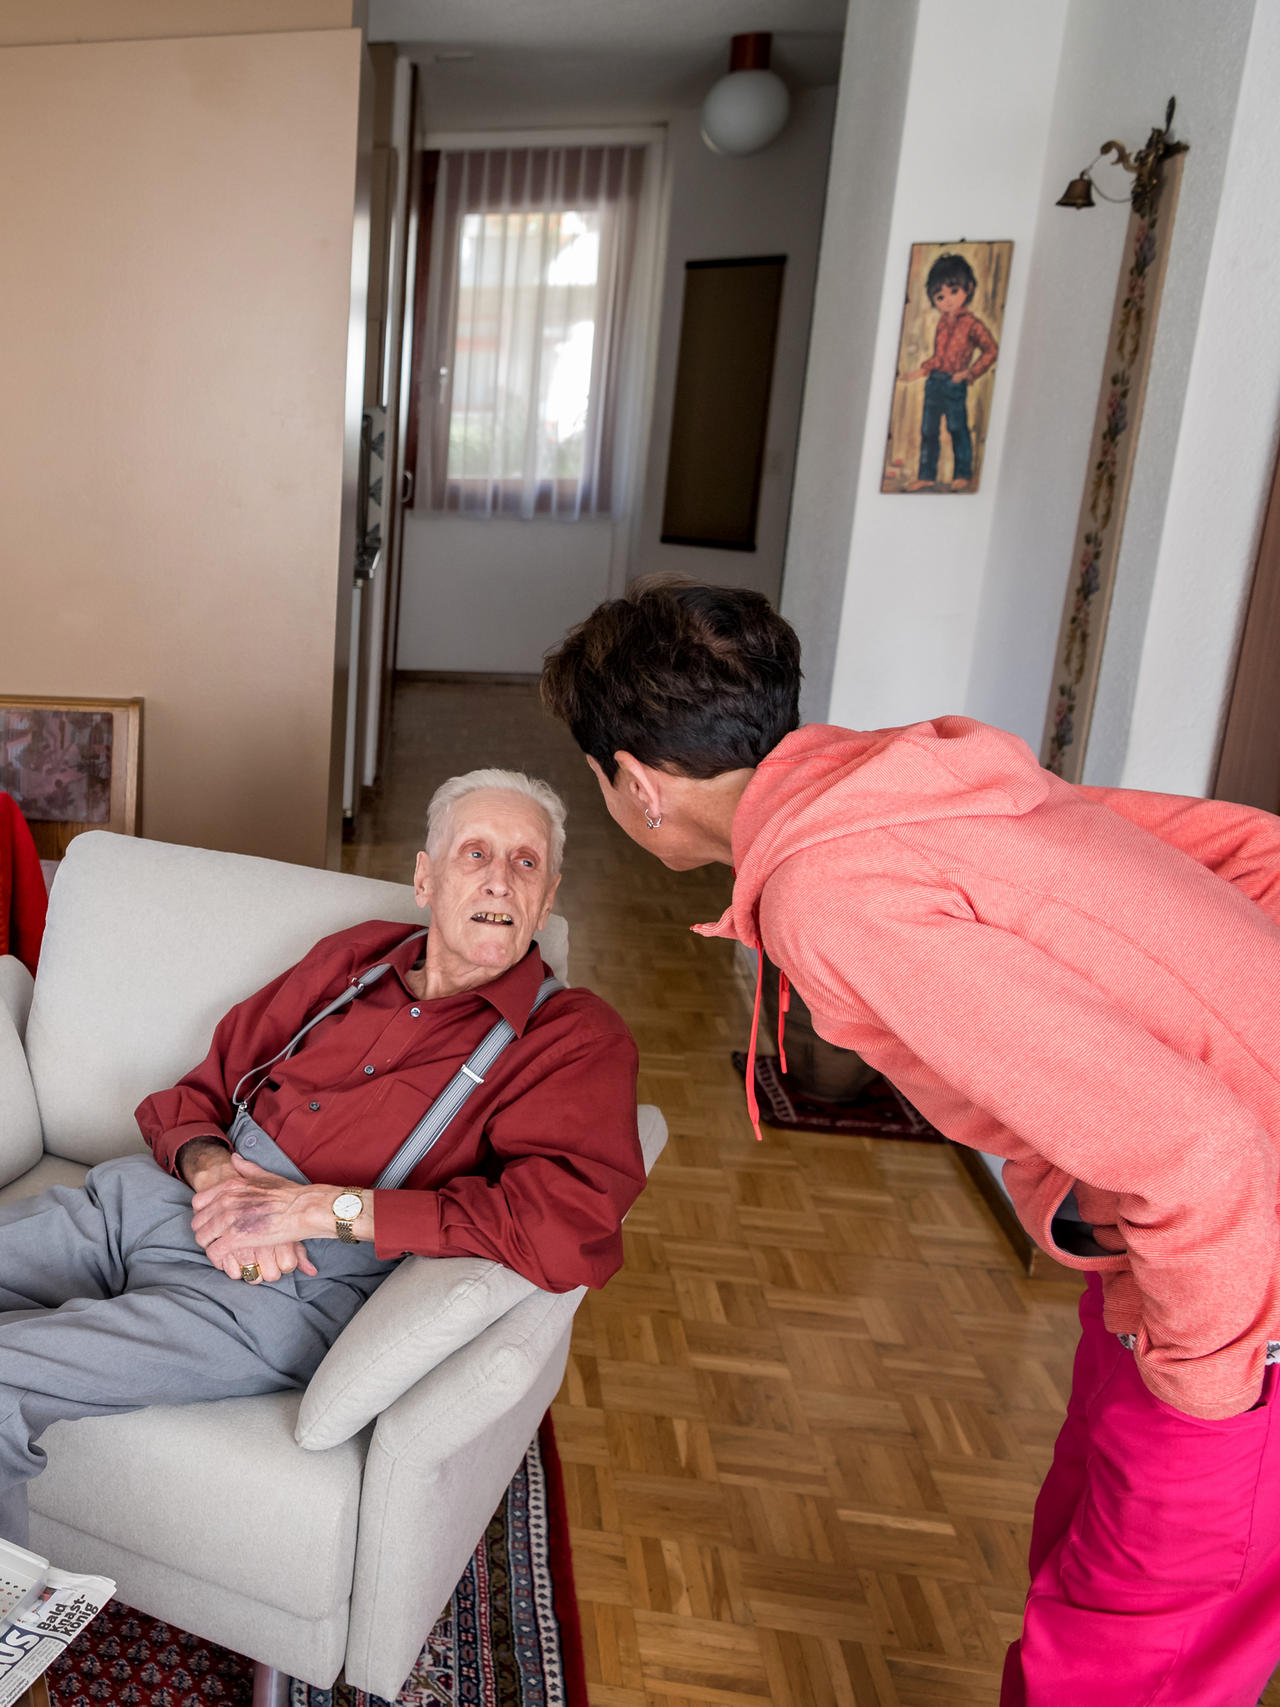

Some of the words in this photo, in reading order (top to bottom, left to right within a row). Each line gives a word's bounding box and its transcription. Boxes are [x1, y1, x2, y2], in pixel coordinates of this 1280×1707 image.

[36, 1603, 68, 1632] Bald
[48, 1593, 86, 1634] Knast-
[59, 1602, 99, 1637] König
